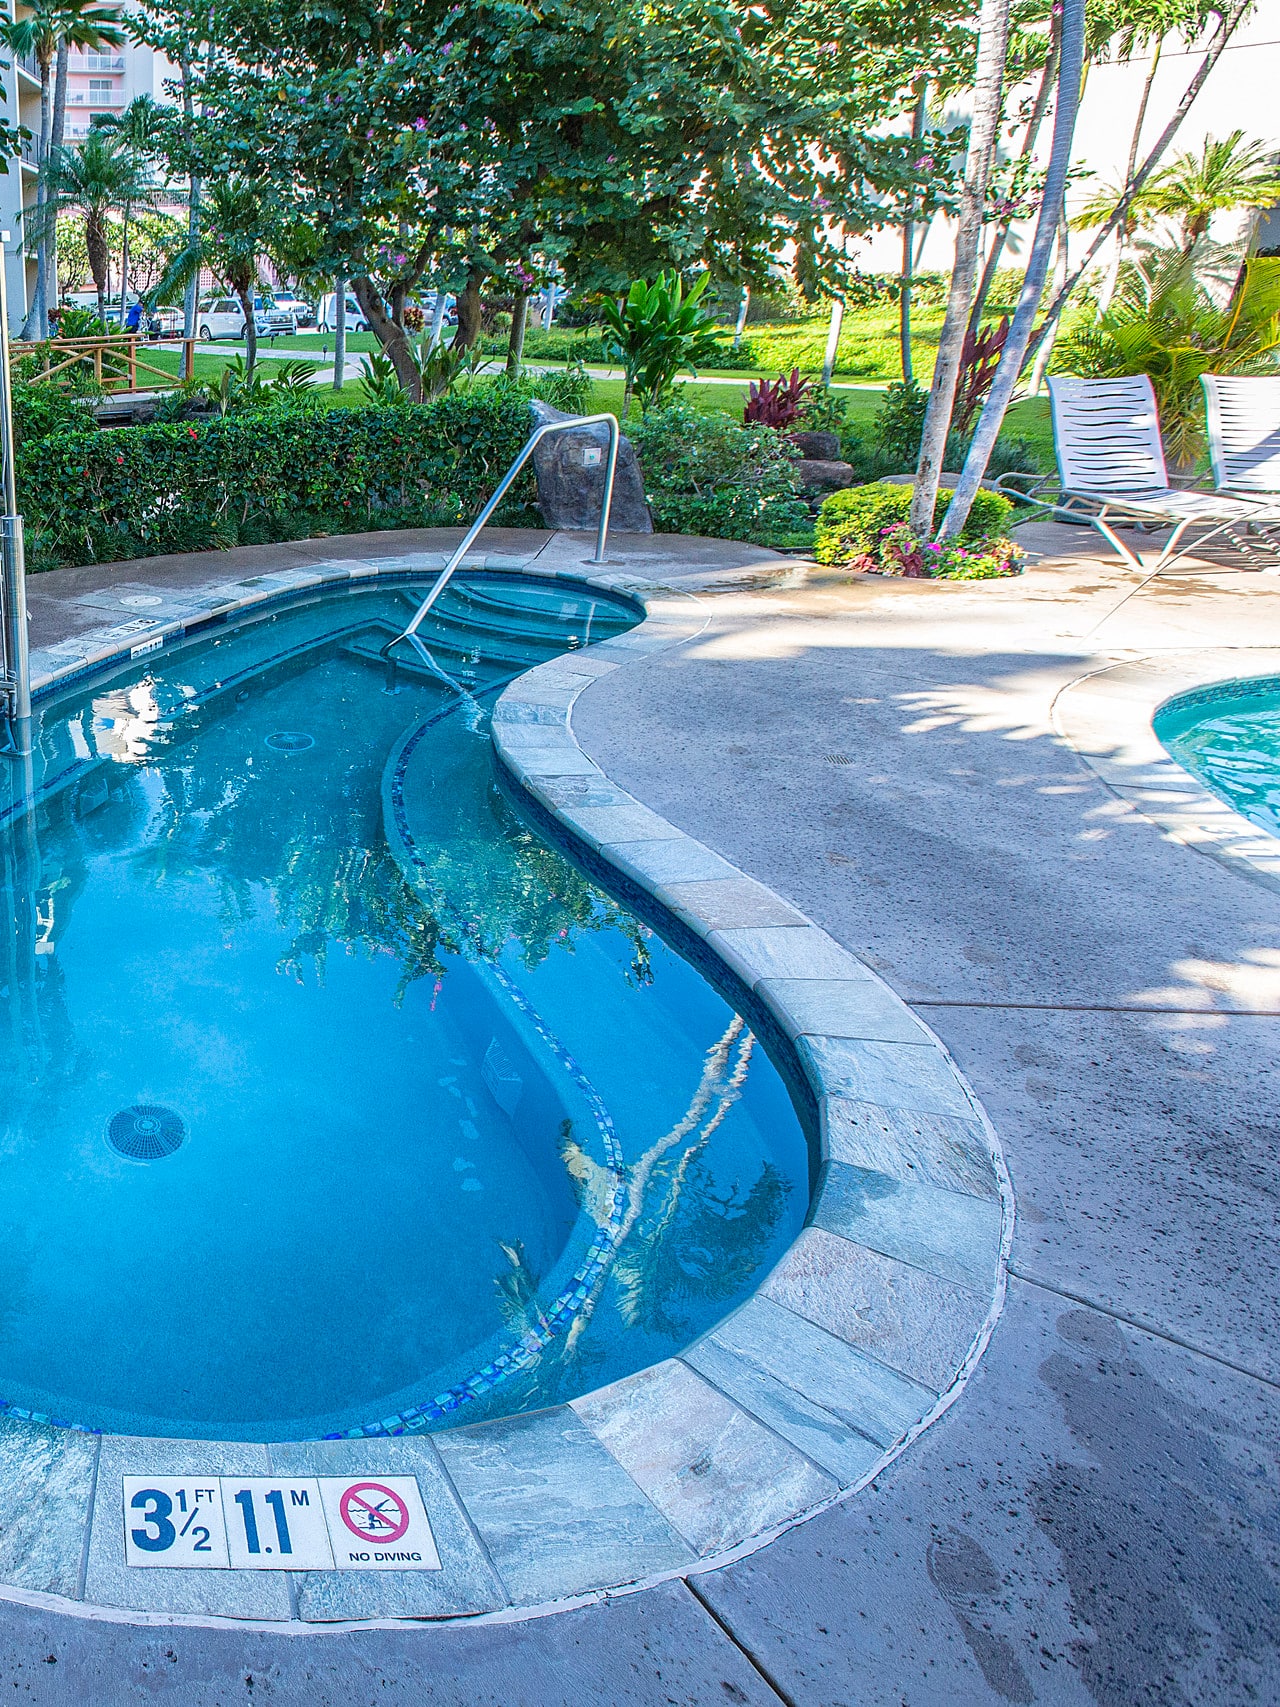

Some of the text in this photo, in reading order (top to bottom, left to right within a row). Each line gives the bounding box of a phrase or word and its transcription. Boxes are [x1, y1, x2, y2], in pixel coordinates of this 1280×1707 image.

[195, 1489, 215, 1503] FT
[234, 1489, 310, 1554] 1.1 M
[349, 1551, 422, 1562] NO DIVING
